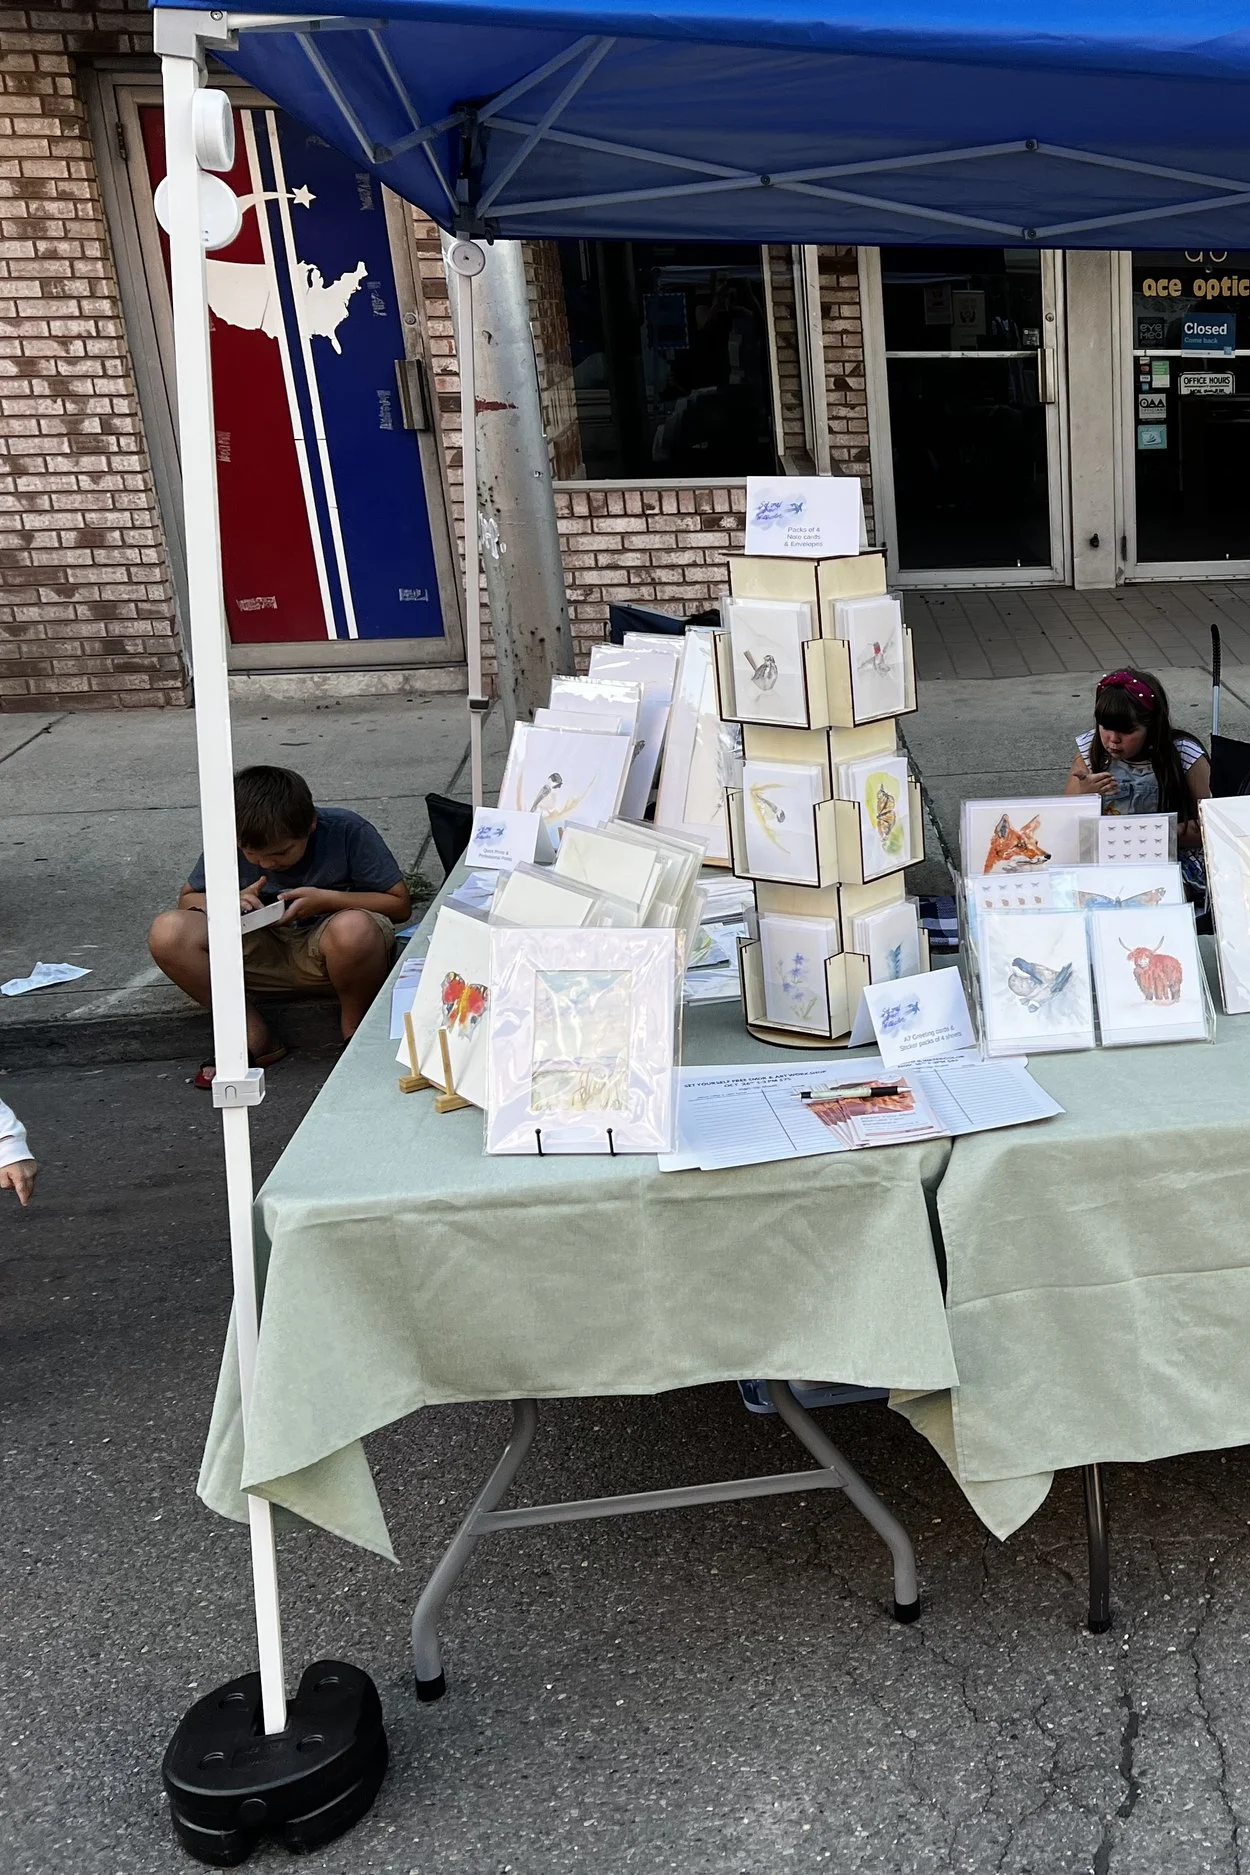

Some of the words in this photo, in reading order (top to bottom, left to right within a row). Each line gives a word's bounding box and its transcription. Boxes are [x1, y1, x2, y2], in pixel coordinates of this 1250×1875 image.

[1142, 277, 1182, 297] ace
[1184, 322, 1228, 335] Closed
[1183, 376, 1207, 385] OFFICE
[1208, 376, 1231, 385] HOURS
[911, 1030, 935, 1040] Greeting
[899, 1042, 918, 1052] Sticker
[918, 1038, 935, 1048] packs
